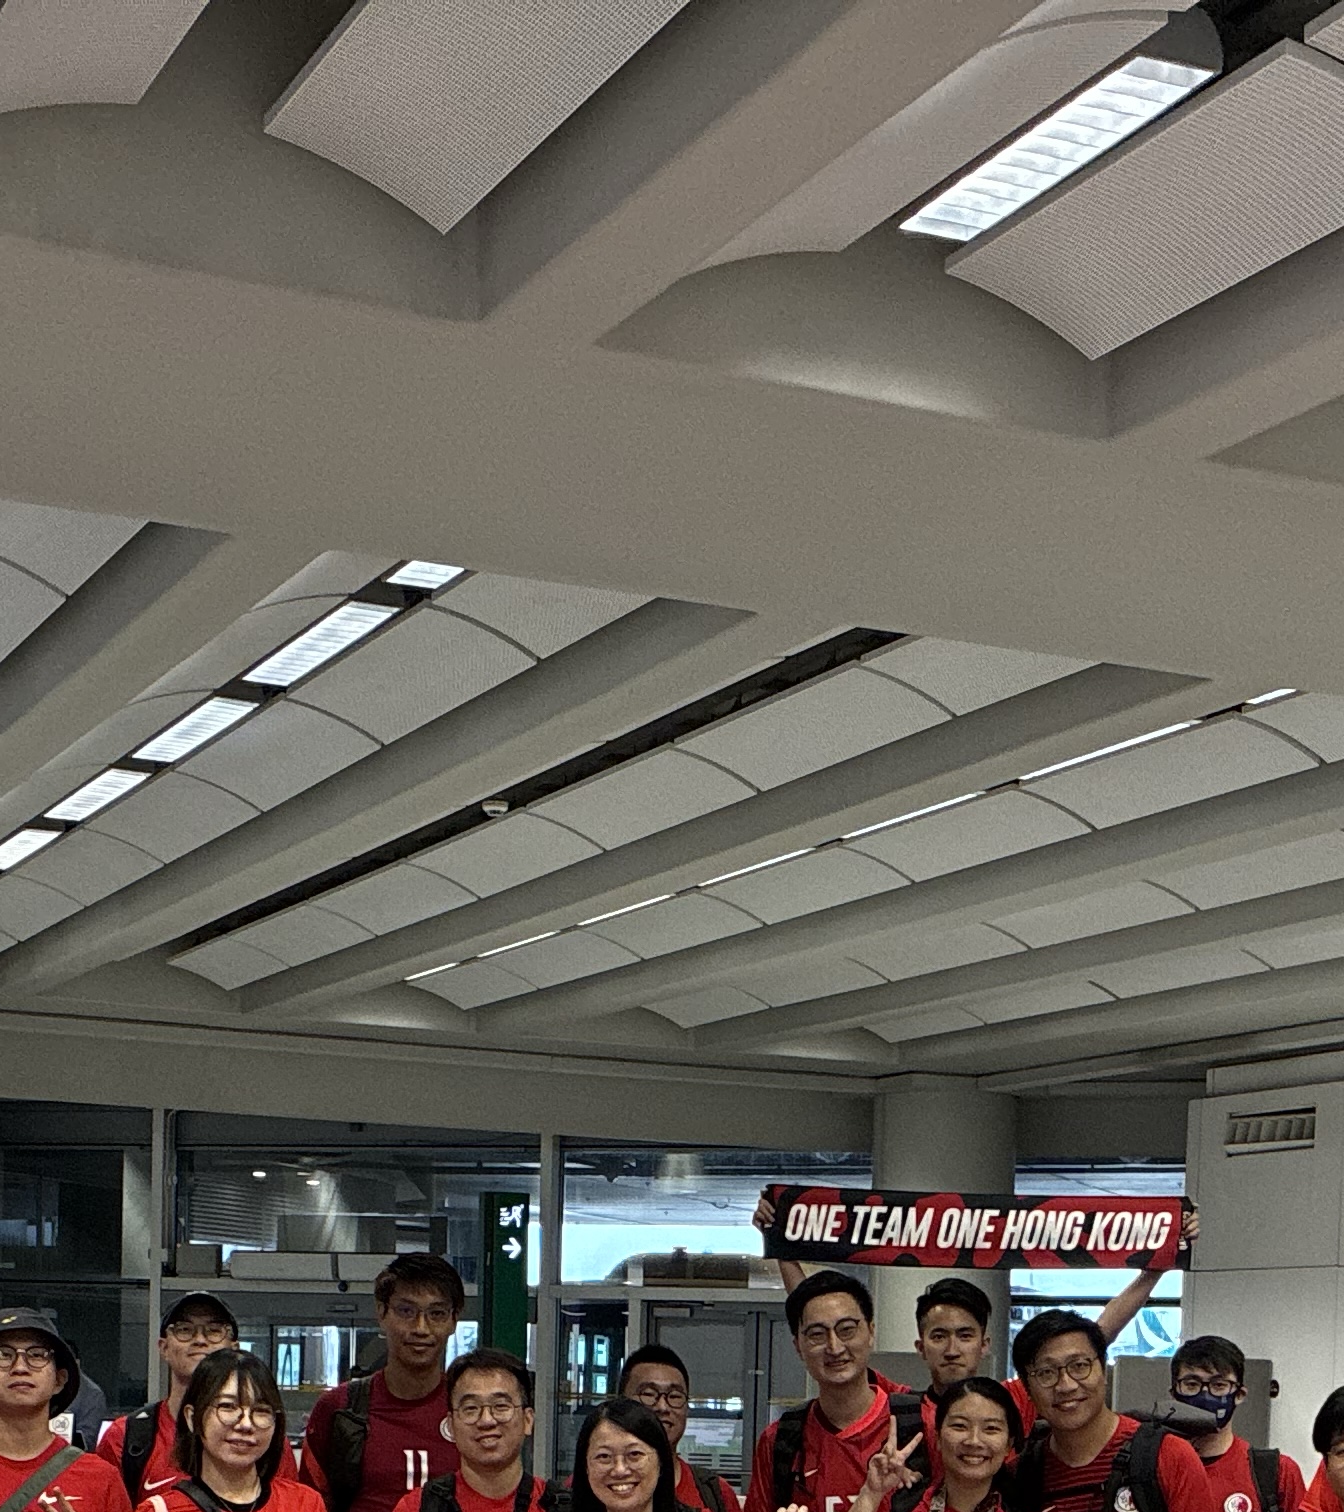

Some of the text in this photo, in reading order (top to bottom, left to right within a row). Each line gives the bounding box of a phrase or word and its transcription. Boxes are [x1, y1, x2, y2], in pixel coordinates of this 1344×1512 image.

[784, 1203, 843, 1242] ONE
[850, 1205, 936, 1248] TEAM
[936, 1207, 1000, 1250] ONE
[1000, 1210, 1085, 1251] HONG
[1085, 1211, 1173, 1252] KONG
[403, 1449, 430, 1491] 11
